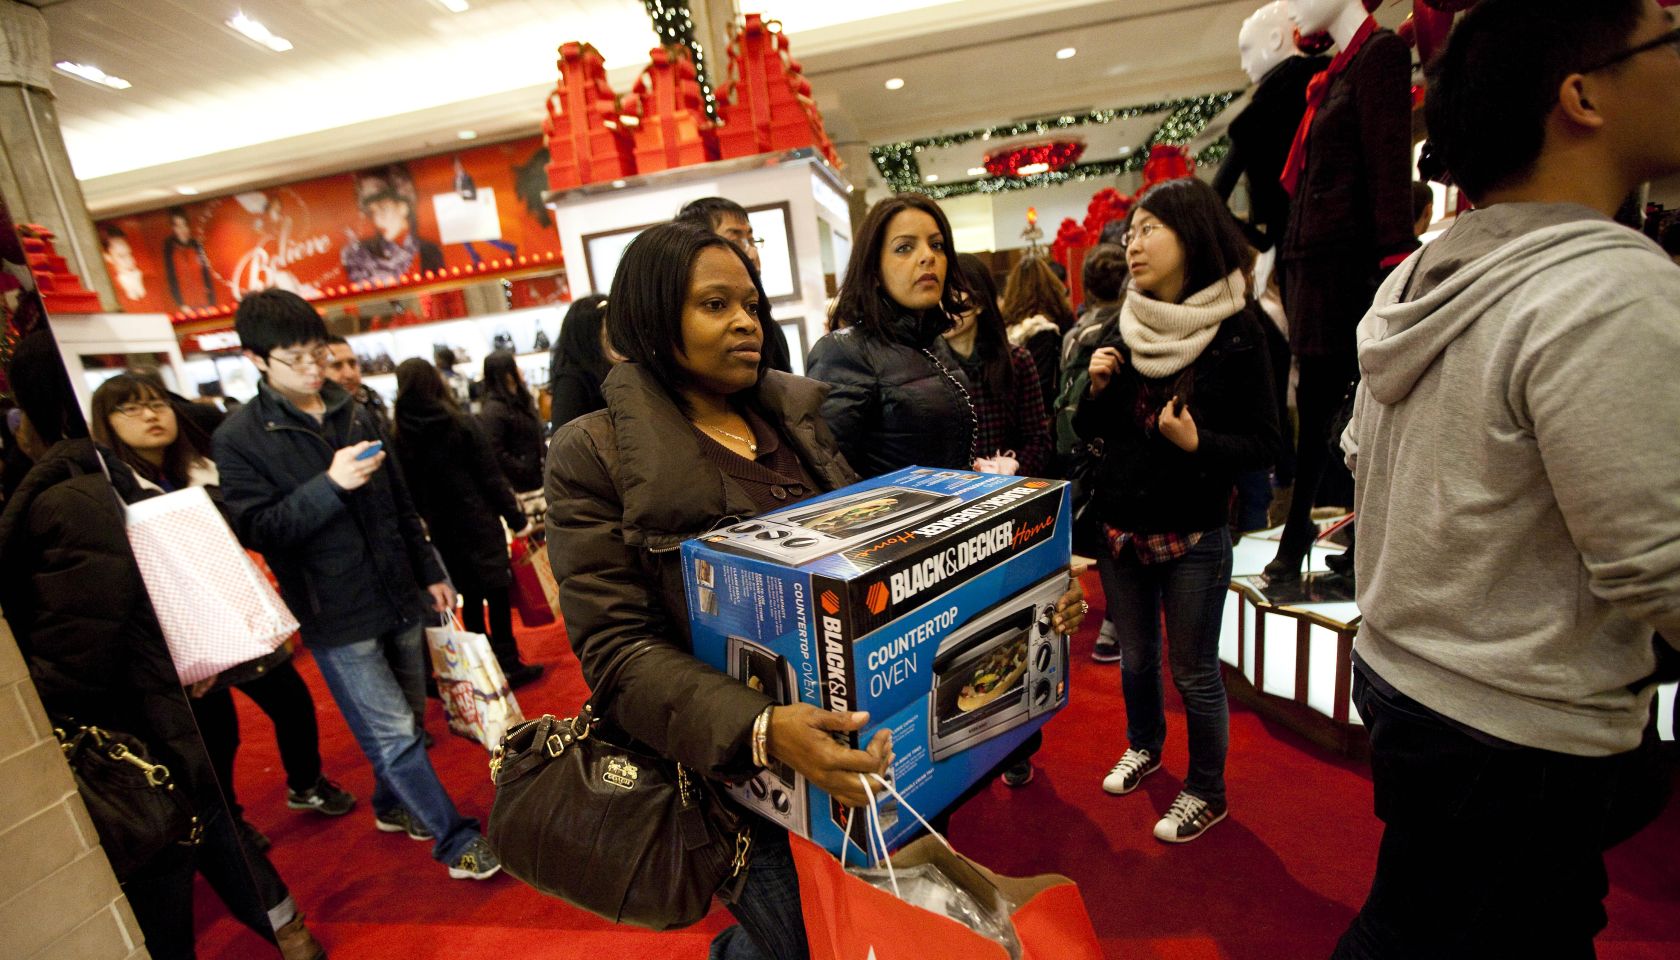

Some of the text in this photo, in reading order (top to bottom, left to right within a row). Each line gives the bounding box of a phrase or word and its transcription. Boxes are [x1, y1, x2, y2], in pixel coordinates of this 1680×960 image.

[232, 215, 331, 302] Believe
[854, 530, 916, 560] Home
[1011, 515, 1055, 550] Home
[793, 582, 815, 699] COUNTERTOP OVEN
[868, 606, 958, 671] COUNTERTOP
[870, 652, 918, 698] OVEN
